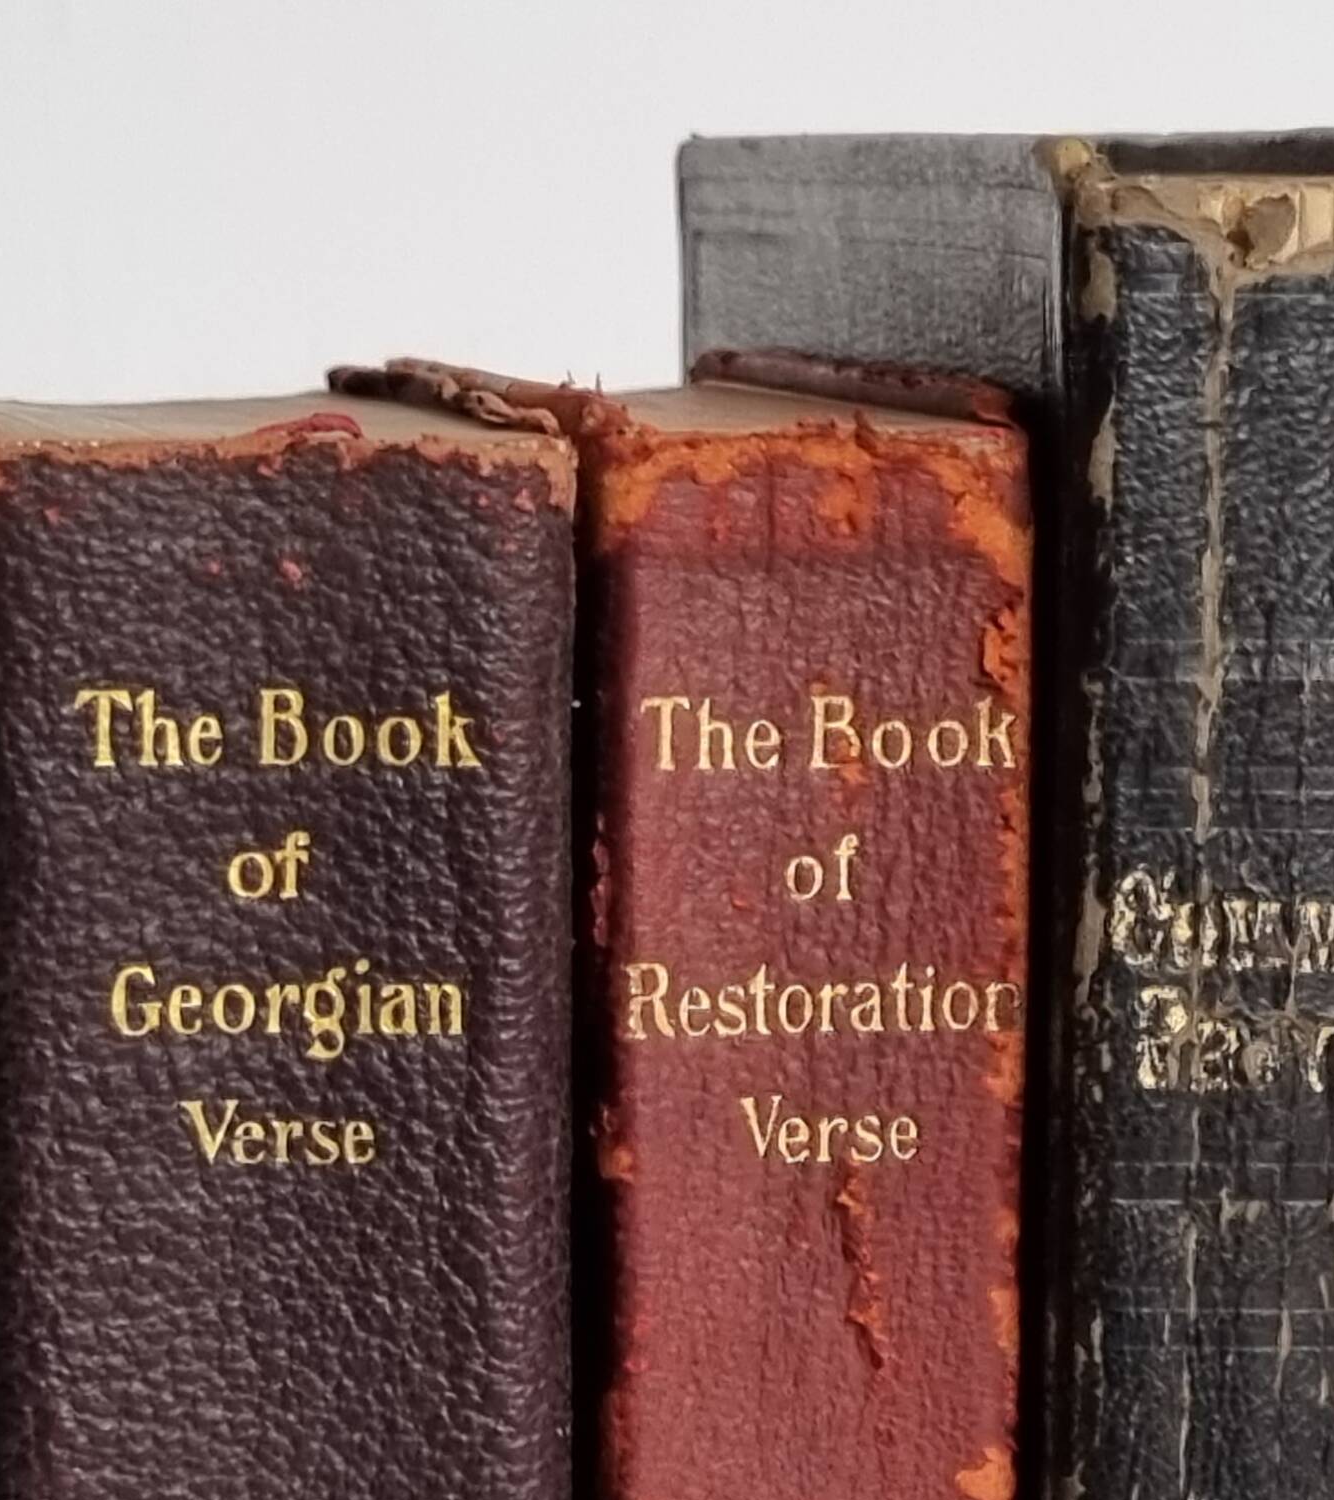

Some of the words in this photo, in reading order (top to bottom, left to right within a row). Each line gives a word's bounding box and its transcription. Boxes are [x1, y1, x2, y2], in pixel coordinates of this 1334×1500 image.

[74, 688, 223, 768] The
[258, 687, 482, 768] Book
[639, 696, 782, 771] The
[809, 694, 1017, 770] Book
[226, 830, 311, 900] of
[785, 833, 860, 901] of
[110, 958, 464, 1061] Georgian
[178, 1099, 376, 1166] Verse
[739, 1094, 920, 1165] Verse
